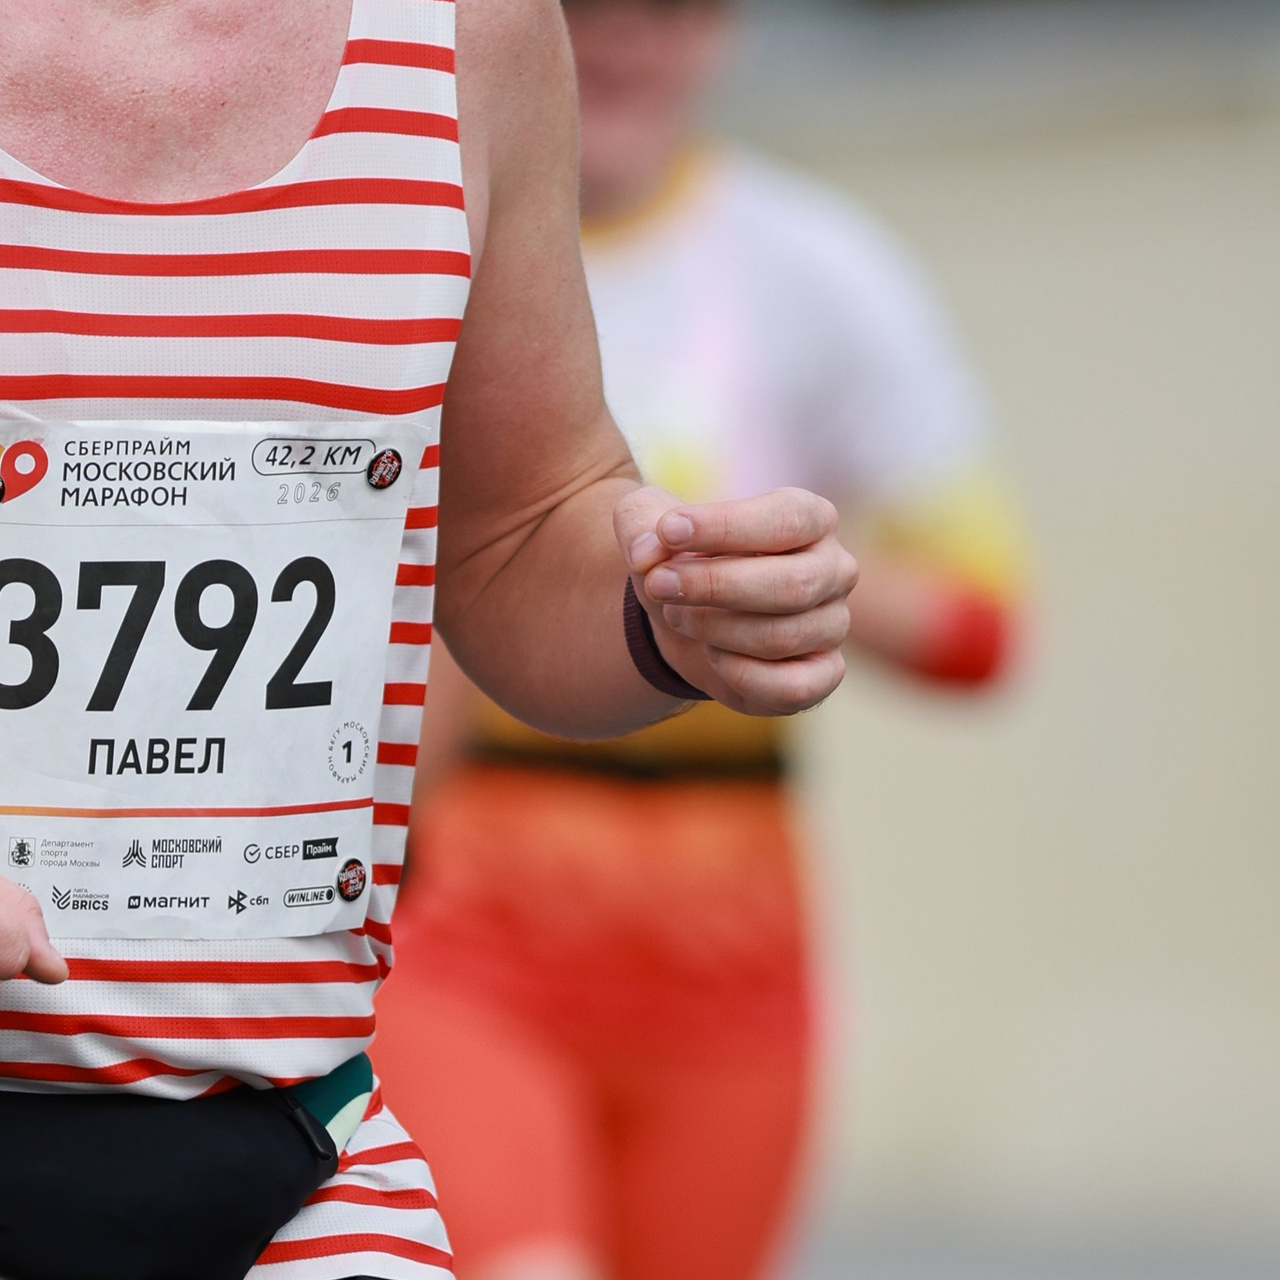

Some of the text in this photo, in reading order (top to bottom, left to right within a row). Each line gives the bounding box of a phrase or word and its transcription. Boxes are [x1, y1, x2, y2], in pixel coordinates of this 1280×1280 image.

[64, 437, 191, 456] СБЕРПРАЙМ
[265, 446, 316, 468] 42,2
[62, 457, 236, 482] МОСКОВСКИЙ
[60, 486, 187, 507] МАРАФОН
[277, 482, 341, 505] 2026
[87, 737, 226, 775] ПАВЕЛ
[342, 740, 352, 763] 1
[40, 839, 94, 848] Департамент
[151, 835, 222, 853] МОСКОВСКИЙ
[265, 842, 332, 859] СБЕР Прайм
[40, 849, 68, 858] спорта
[151, 854, 185, 868] СПОРТ
[40, 859, 67, 867] города
[72, 900, 109, 910] BRICS
[143, 896, 210, 908] магнит
[249, 895, 269, 906] сбп
[287, 890, 325, 903] WINLINE
